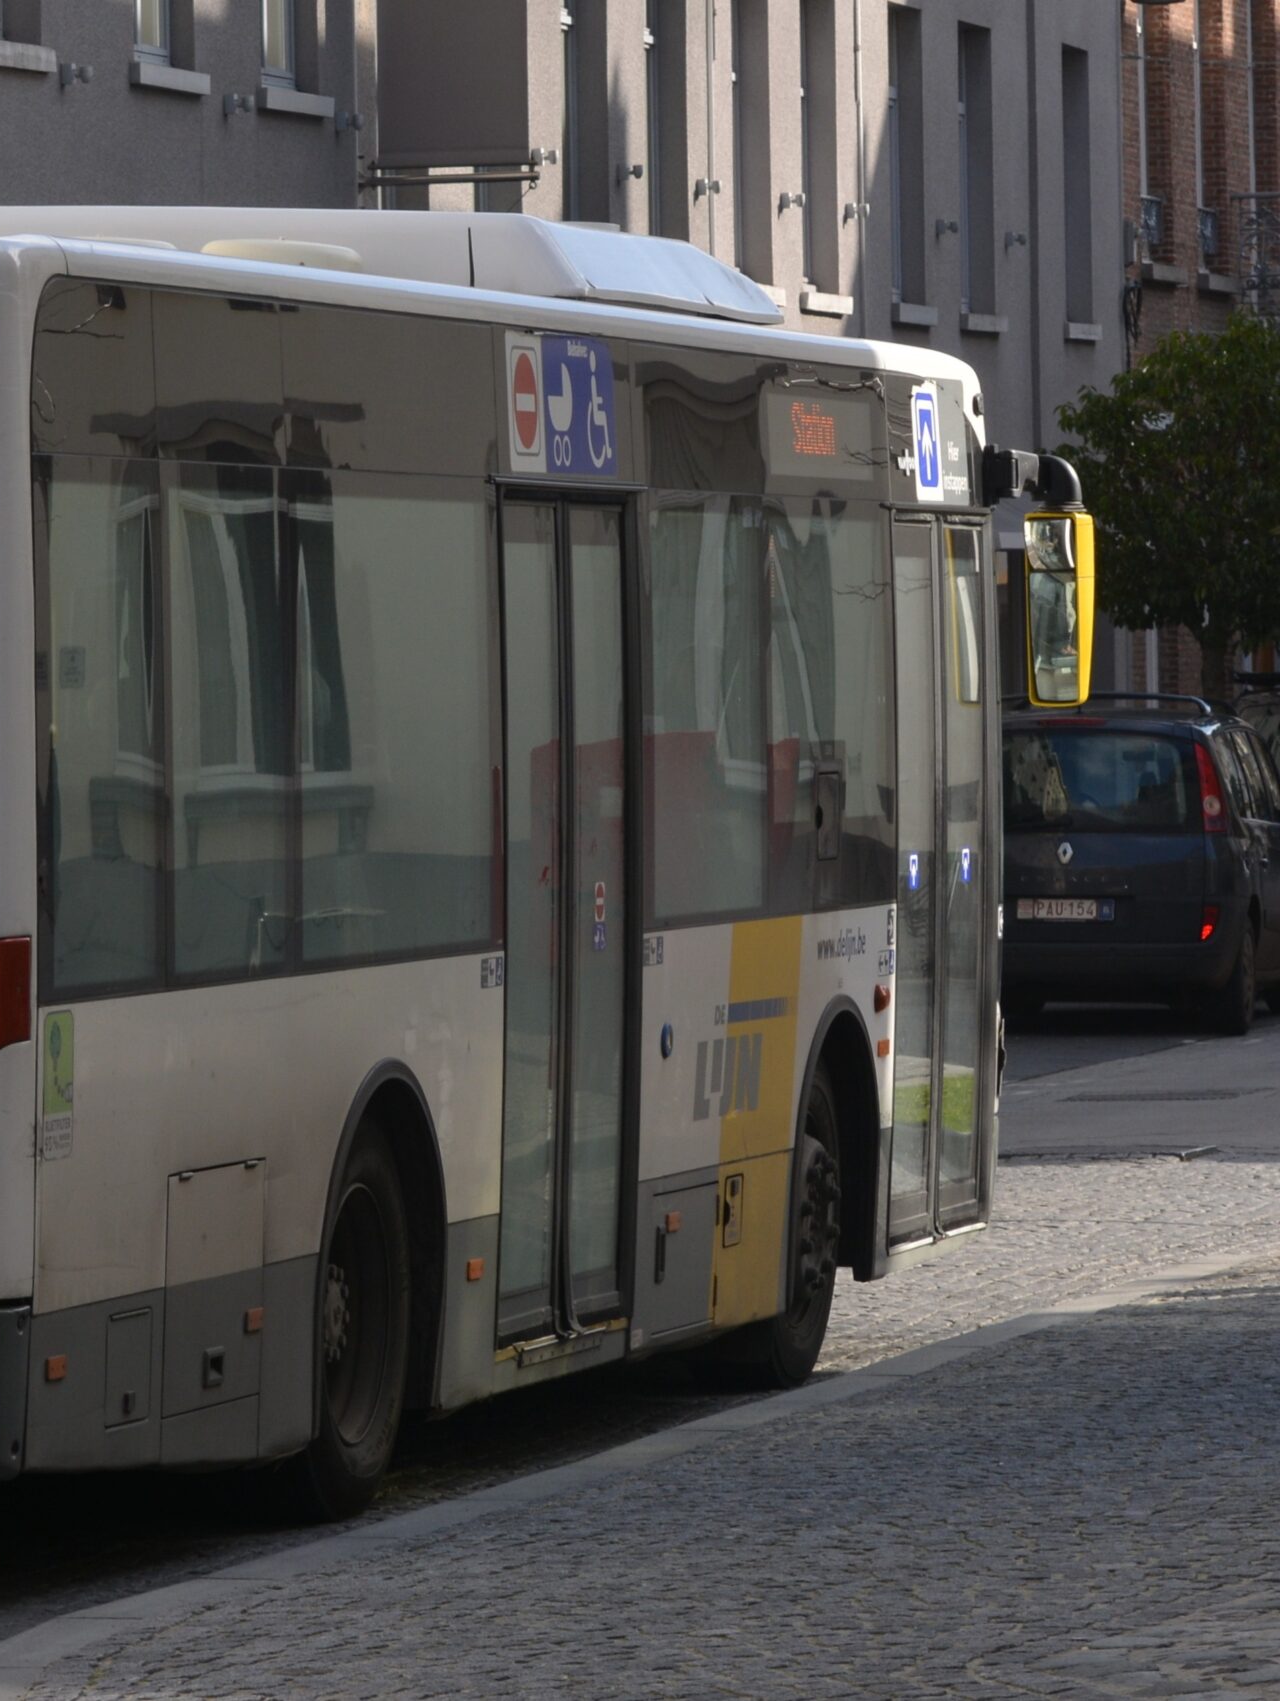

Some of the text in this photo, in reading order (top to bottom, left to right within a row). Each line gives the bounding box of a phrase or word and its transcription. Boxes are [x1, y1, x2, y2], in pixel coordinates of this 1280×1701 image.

[817, 927, 866, 962] www.delijn.be
[714, 1004, 726, 1026] DE
[693, 1033, 763, 1122] LIJN
